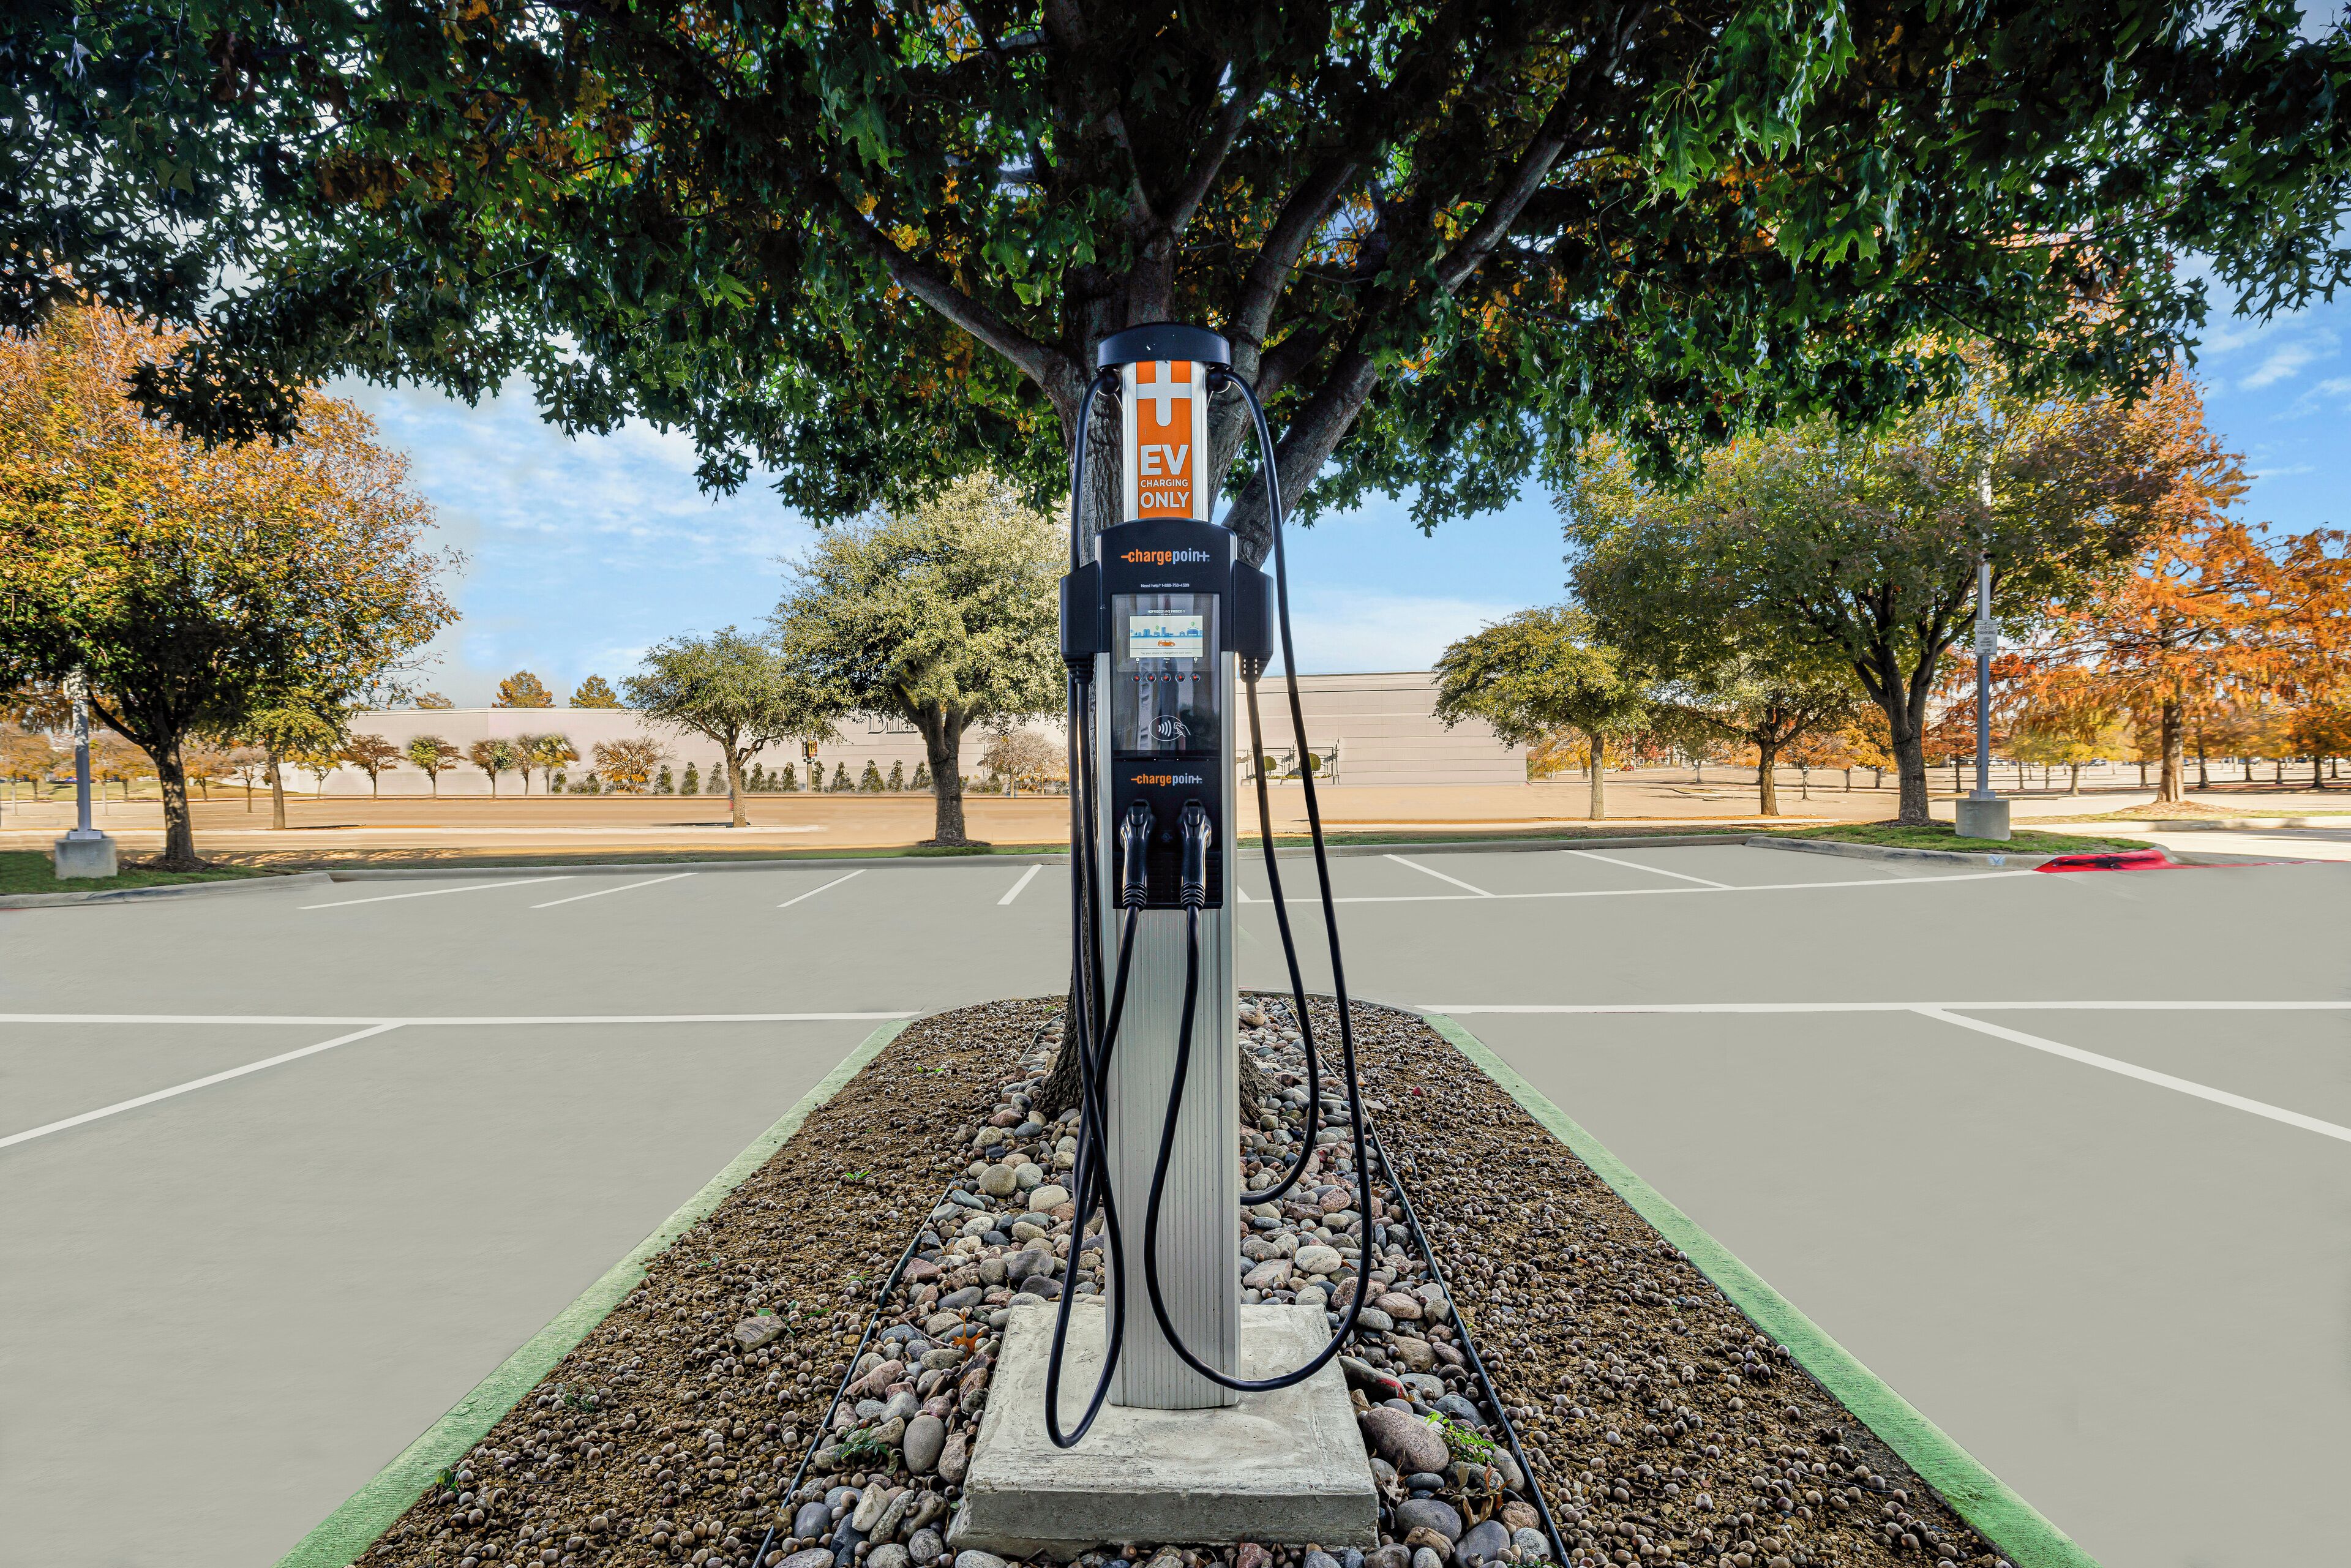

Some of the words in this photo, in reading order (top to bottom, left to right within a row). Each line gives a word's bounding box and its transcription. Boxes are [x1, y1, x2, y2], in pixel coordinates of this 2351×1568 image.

[1140, 444, 1189, 476] EV
[1140, 479, 1188, 488] CHARGING
[1140, 491, 1190, 508] ONLY
